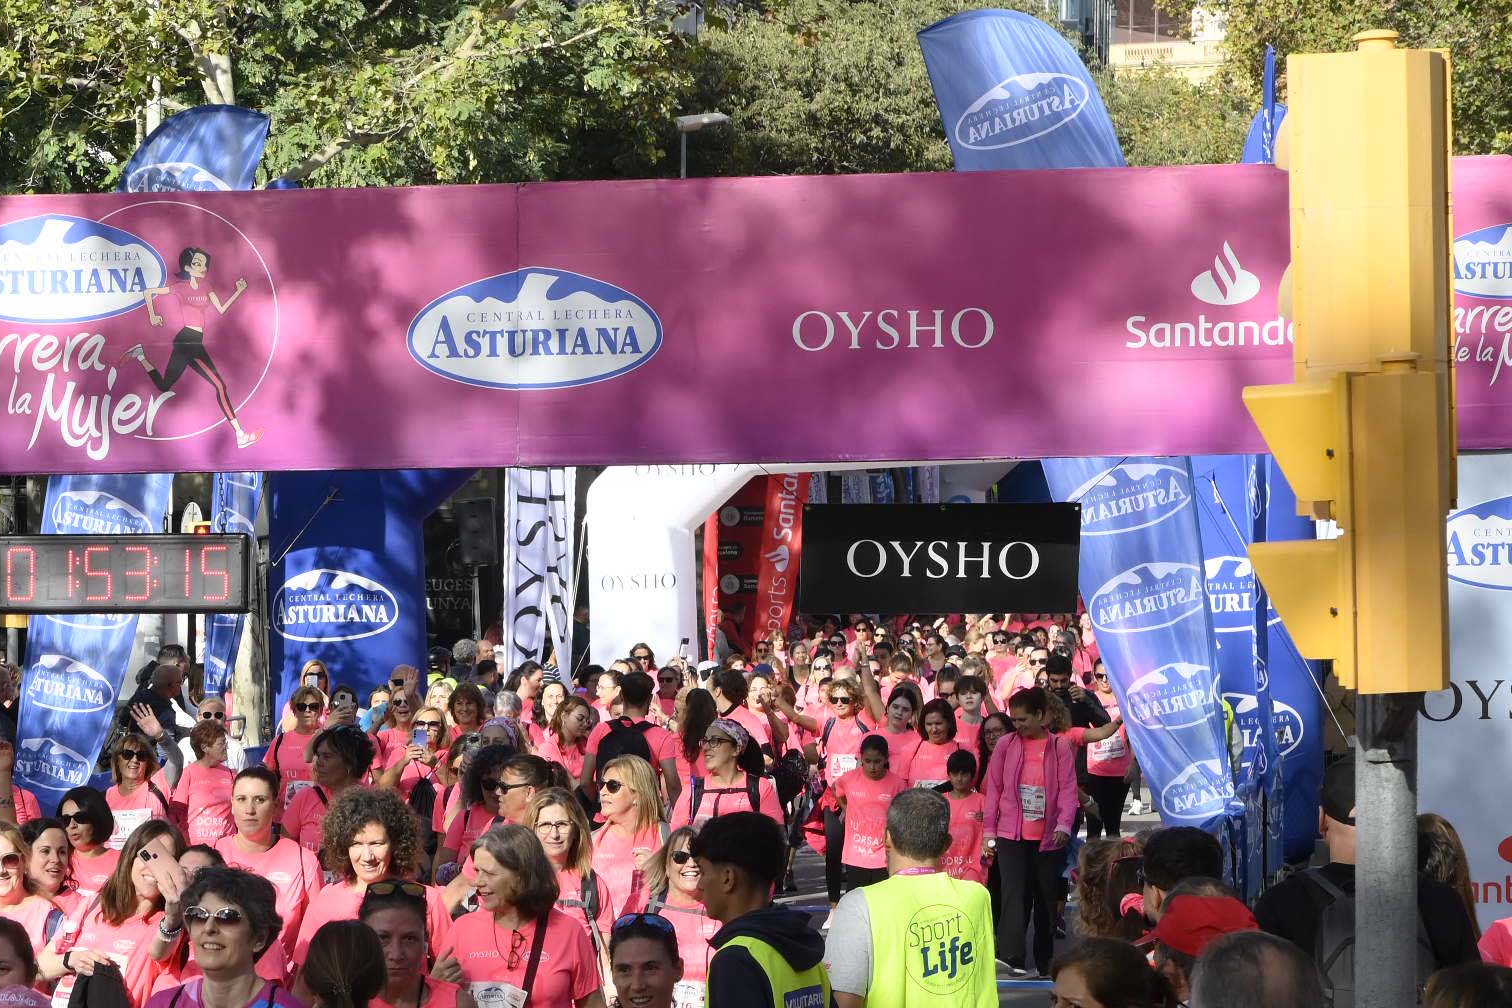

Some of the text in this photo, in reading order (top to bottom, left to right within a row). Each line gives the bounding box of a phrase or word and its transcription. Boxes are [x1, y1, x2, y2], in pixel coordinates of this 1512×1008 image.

[427, 314, 642, 359] ASTURIANA
[467, 308, 634, 323] CENTRAL LECHERA
[792, 307, 995, 352] OYSHO
[8, 374, 31, 414] la
[27, 367, 176, 460] Mujer
[7, 546, 230, 601] 01:53:15
[846, 538, 1040, 580] OYSHO
[276, 599, 389, 625] ASTURIANA
[1418, 679, 1512, 721] OY
[15, 758, 84, 785] STURIANA
[909, 911, 964, 948] Sport
[920, 936, 974, 979] Life
